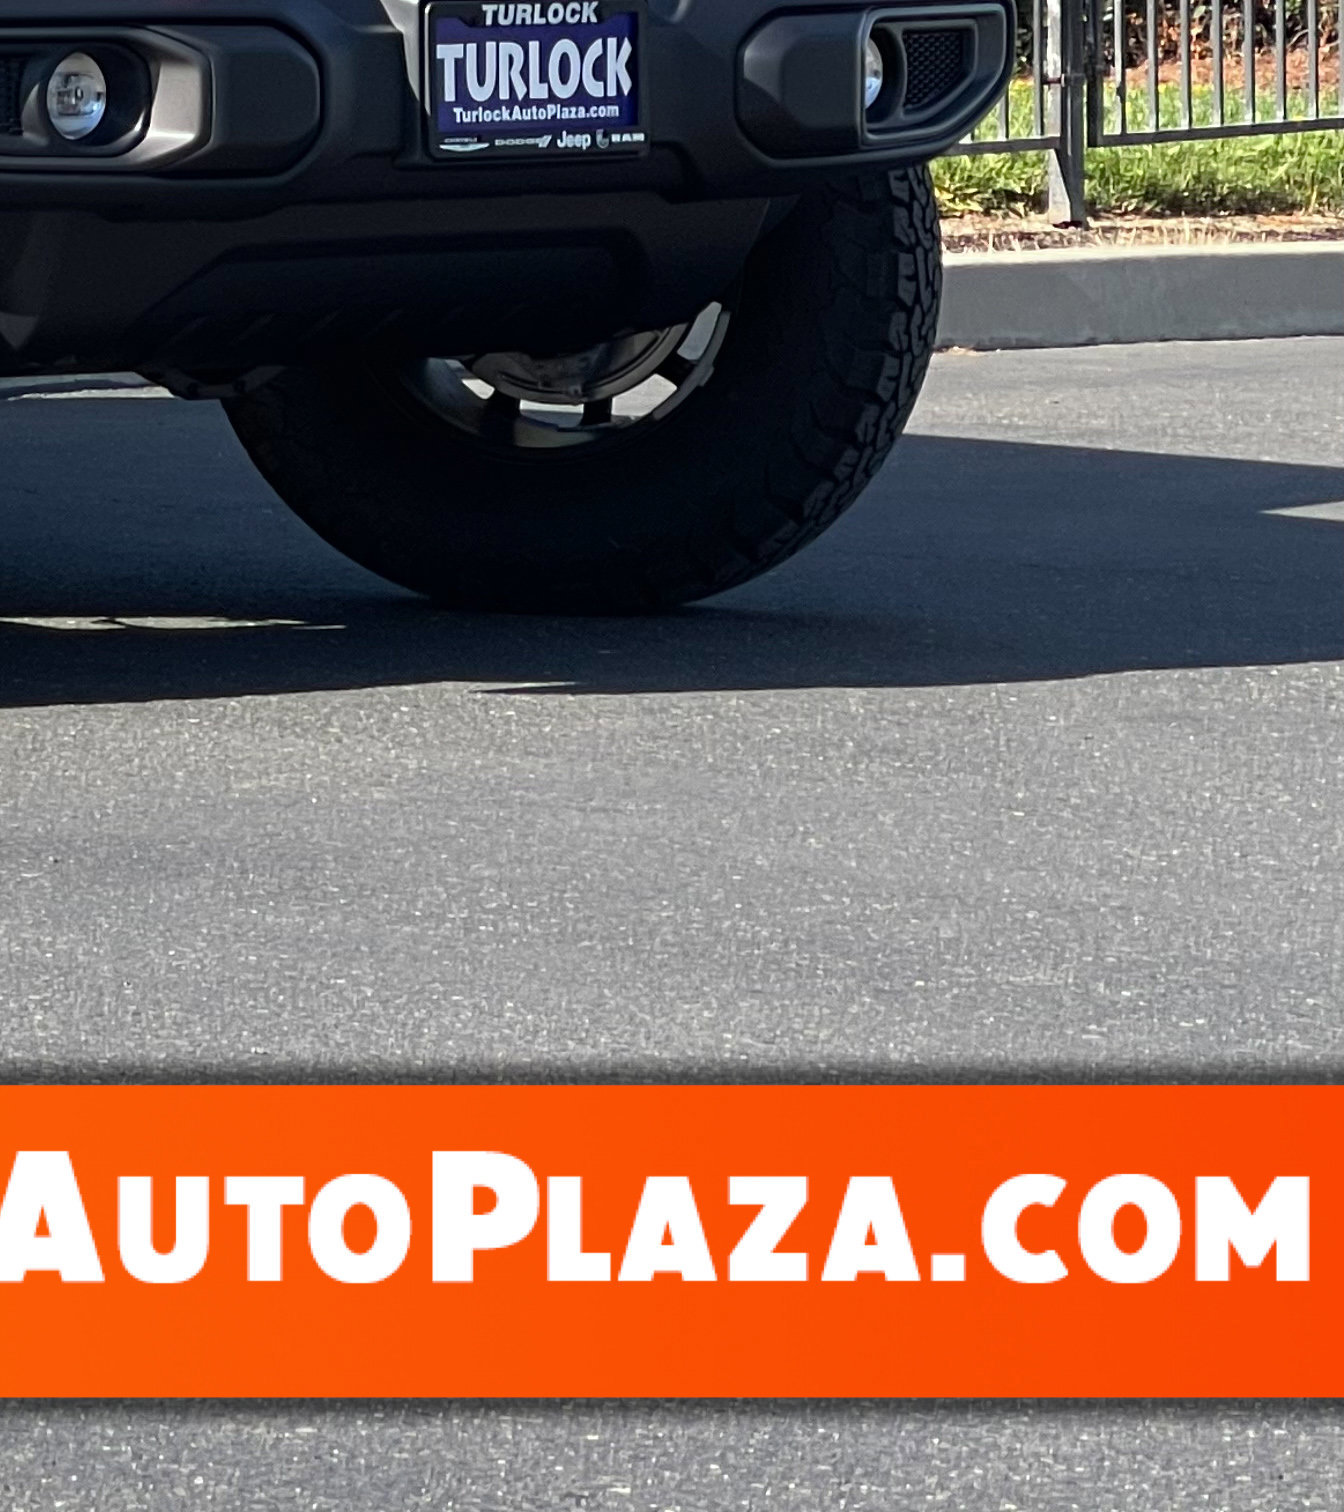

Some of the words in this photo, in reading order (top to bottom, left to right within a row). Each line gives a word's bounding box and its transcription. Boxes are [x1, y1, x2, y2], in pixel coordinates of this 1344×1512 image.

[482, 1, 599, 25] TURLOCK
[436, 36, 632, 102] TURLOCK
[453, 104, 619, 124] TurlockAutoPlaza.com
[557, 130, 590, 150] Jeep
